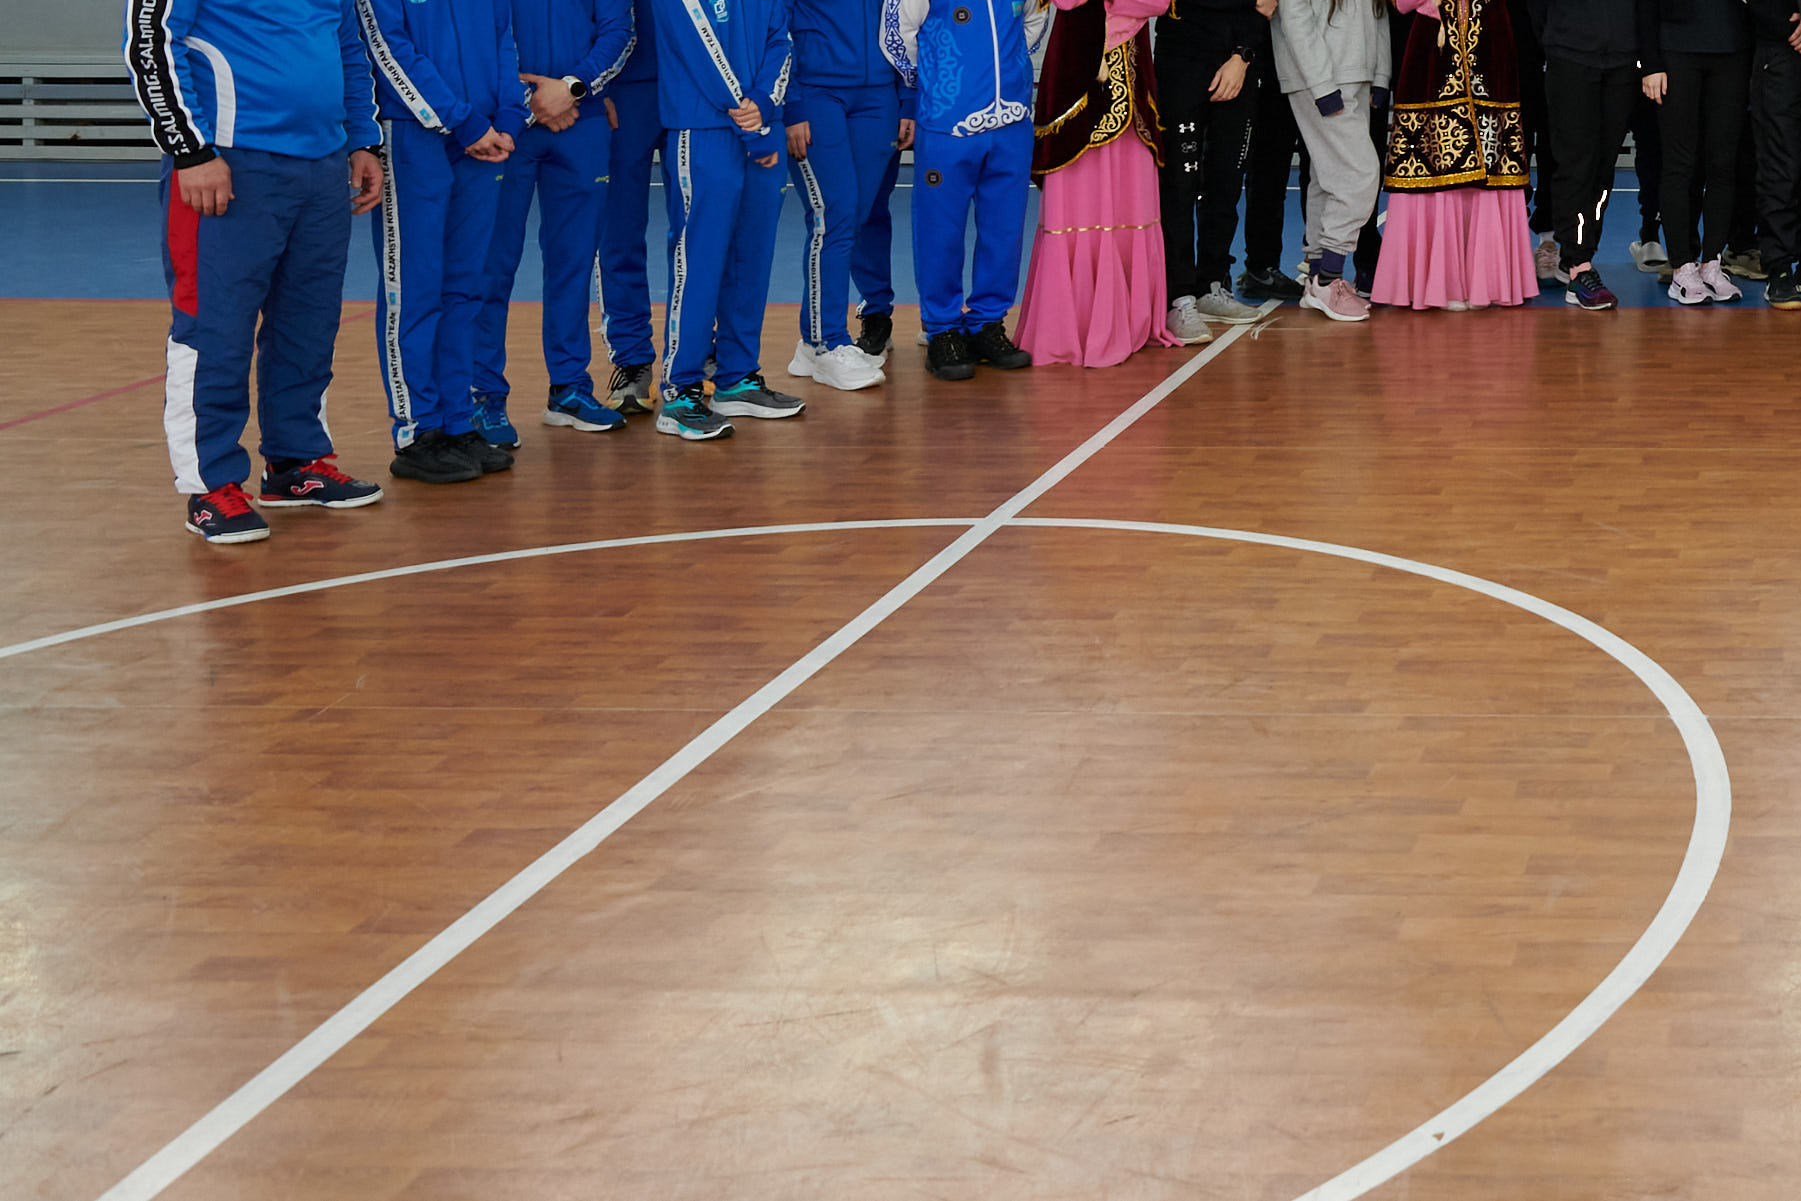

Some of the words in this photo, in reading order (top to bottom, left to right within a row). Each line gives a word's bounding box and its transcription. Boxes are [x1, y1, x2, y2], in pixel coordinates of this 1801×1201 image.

[379, 50, 417, 102] KAZAKHSTAN
[383, 179, 394, 224] NATIONAL
[387, 225, 397, 282] KAZAKHSTAN
